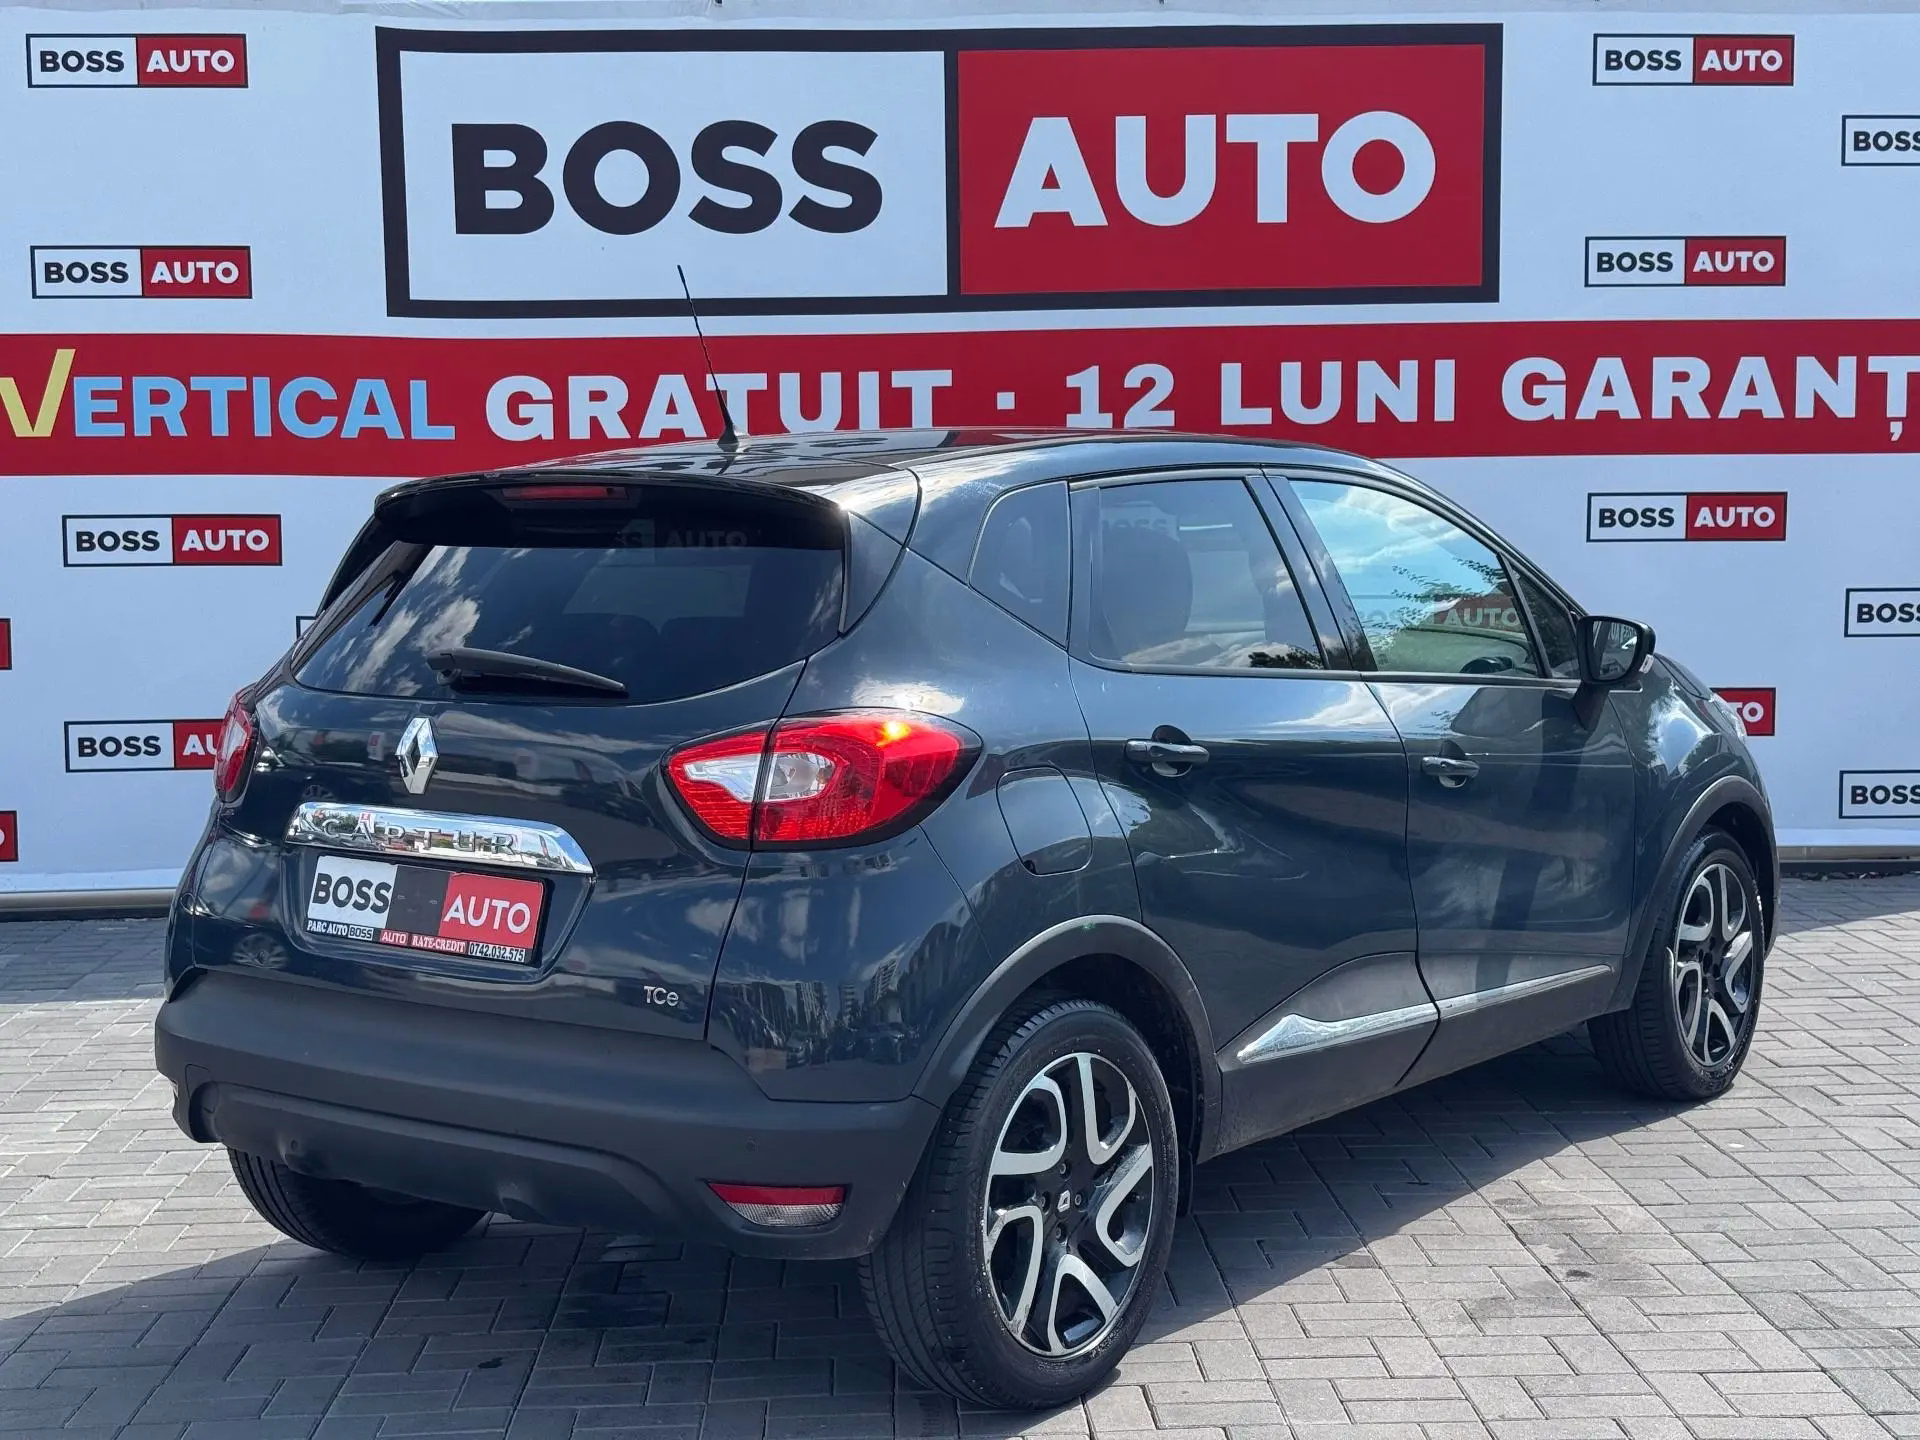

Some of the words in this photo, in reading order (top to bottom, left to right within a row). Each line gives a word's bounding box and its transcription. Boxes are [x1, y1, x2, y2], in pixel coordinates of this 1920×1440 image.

[40, 51, 124, 72] BOSS
[147, 50, 234, 72] AUTO
[1606, 50, 1681, 70] BOSS
[1702, 50, 1782, 71] AUTO
[452, 120, 882, 235] BOSS
[994, 111, 1435, 227] AUTO
[1597, 252, 1673, 272] BOSS
[1693, 251, 1774, 272] AUTO
[45, 262, 128, 283] BOSS
[151, 262, 238, 283] AUTO
[0, 349, 455, 440] VERTICAL
[486, 370, 953, 441] GRATUIT
[1066, 364, 1175, 428] 12
[1221, 360, 1455, 425] LUNI
[1599, 508, 1674, 528] BOSS
[1695, 507, 1775, 528] AUTO
[76, 531, 159, 551] BOSS
[182, 530, 269, 551] AUTO
[1857, 603, 1920, 623] BOS
[78, 735, 161, 757] BOSS
[322, 819, 516, 855] CAPTUR
[312, 873, 392, 914] BOSS
[443, 894, 531, 934] AUTO
[307, 920, 328, 933] PARC
[327, 923, 348, 937] AUTO
[349, 925, 373, 940] BOSS
[381, 931, 407, 944] AUTO
[412, 934, 465, 953] RATE-CREDIT
[644, 986, 679, 1006] TCe
